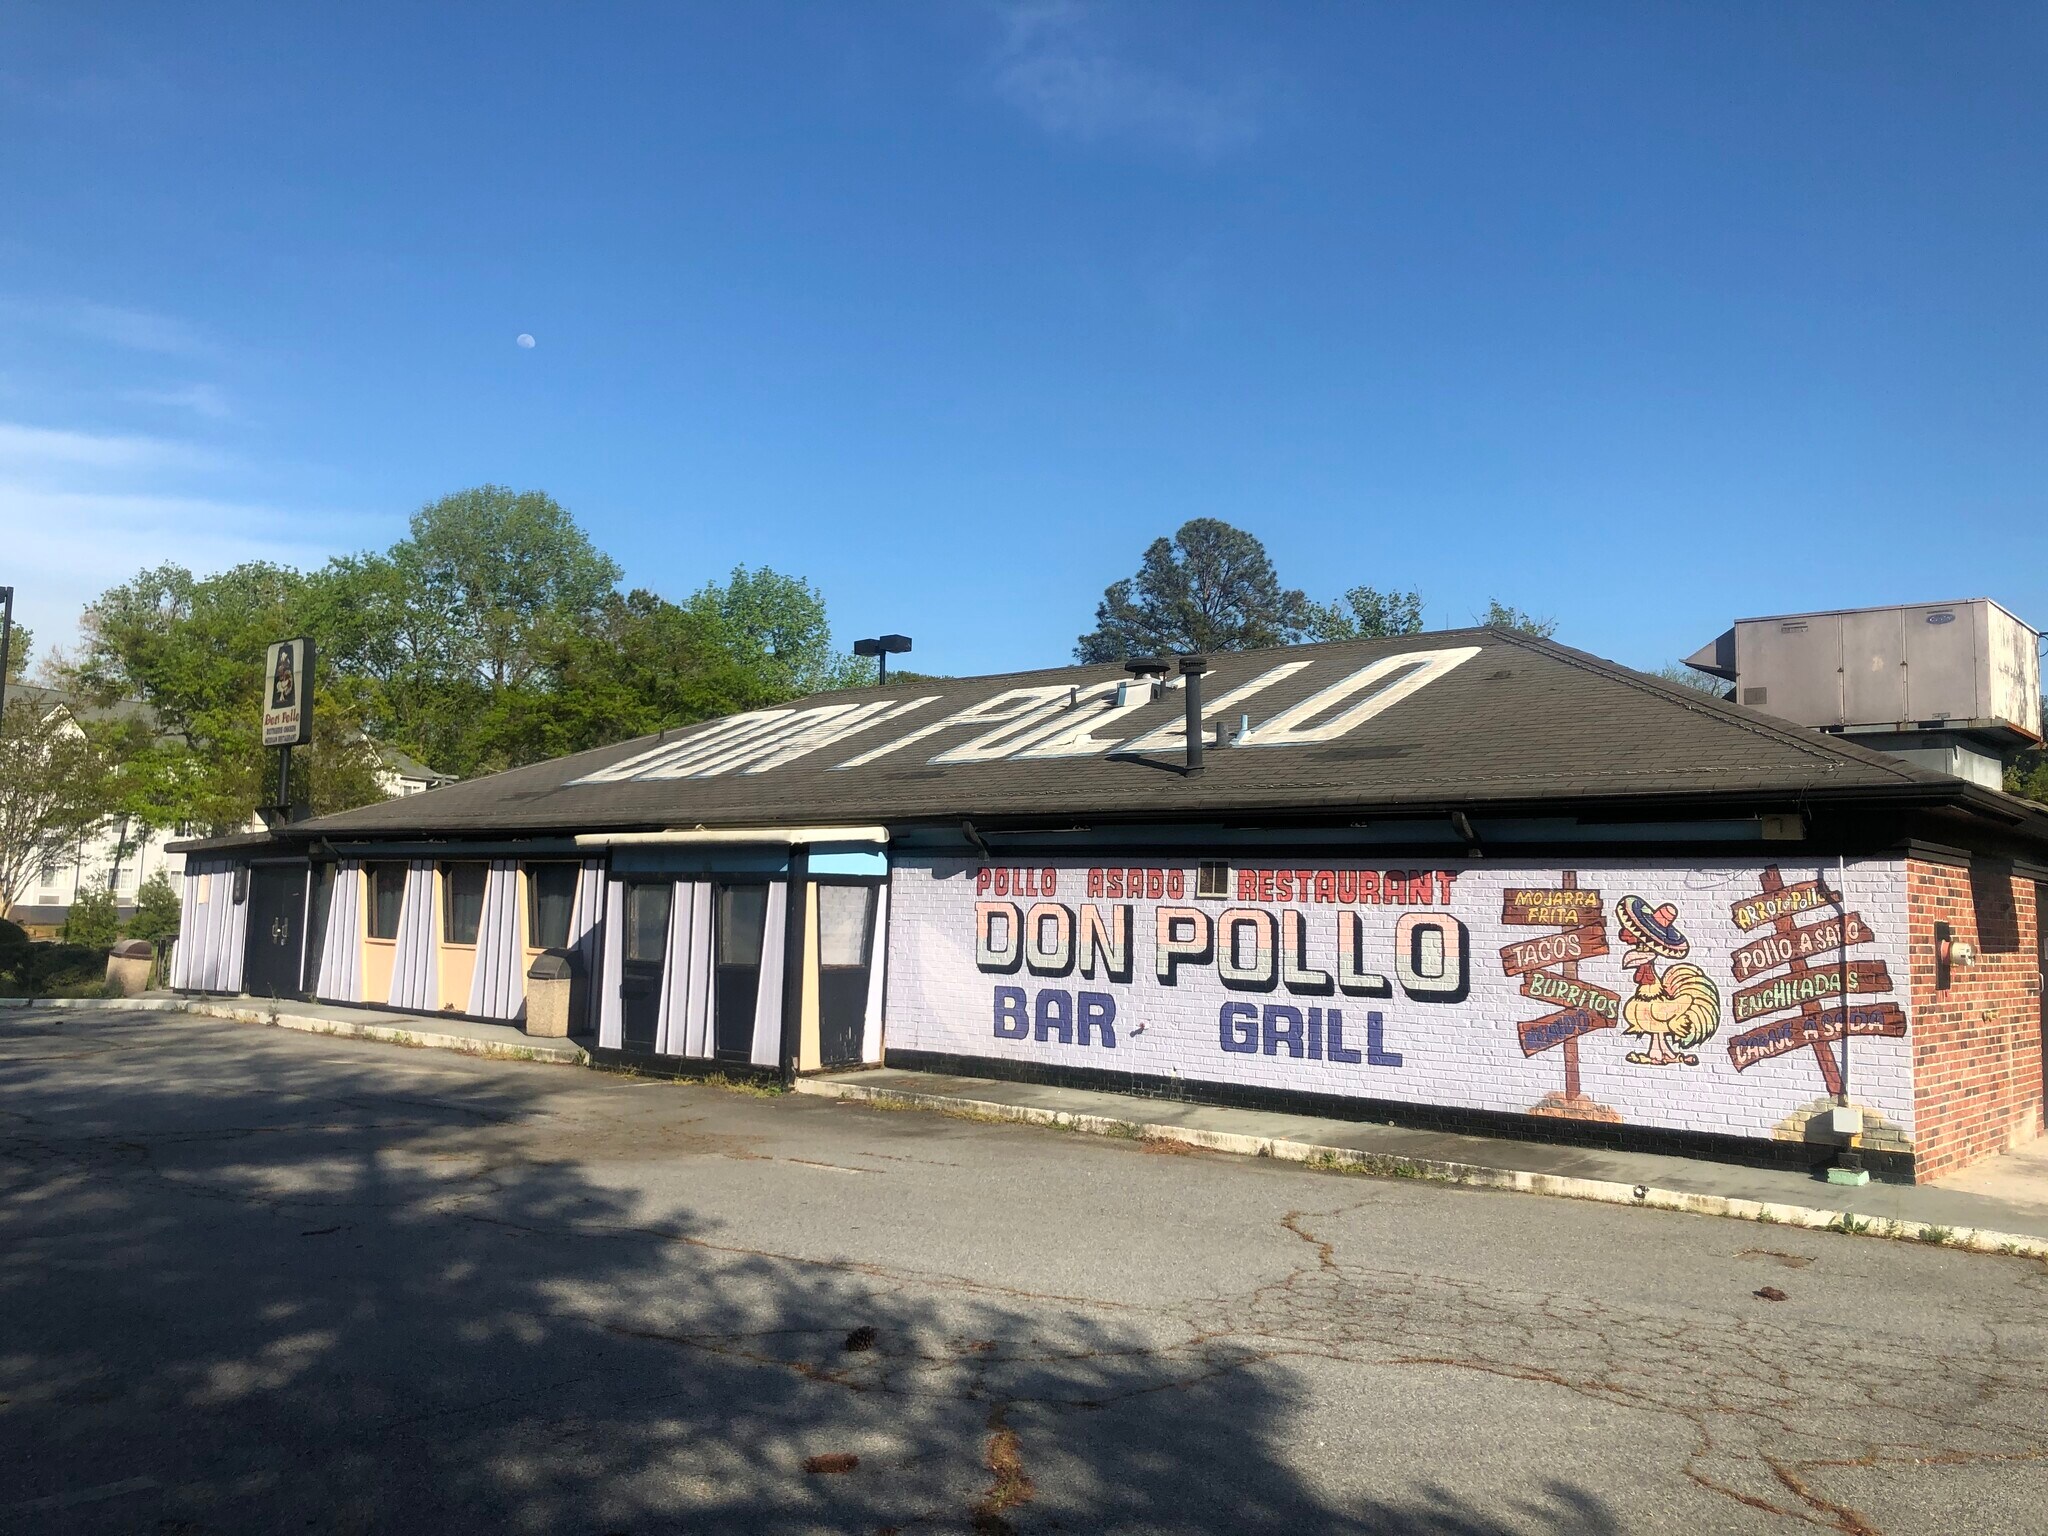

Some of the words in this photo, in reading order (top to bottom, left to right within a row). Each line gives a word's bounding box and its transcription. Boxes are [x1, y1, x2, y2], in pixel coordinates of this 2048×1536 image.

[976, 866, 1057, 897] POLLO
[1087, 867, 1185, 898] ASADO
[1238, 868, 1458, 905] RESTAURANT
[1514, 891, 1598, 906] MOJARRA
[1527, 908, 1579, 924] FRITA
[975, 901, 1133, 983] DON
[1156, 906, 1470, 1003] POLLO
[1529, 973, 1618, 1019] BURRITOS
[1738, 971, 1859, 1017] ENCHILADAS
[993, 985, 1116, 1048] BAR
[1219, 1001, 1403, 1067] GRILL
